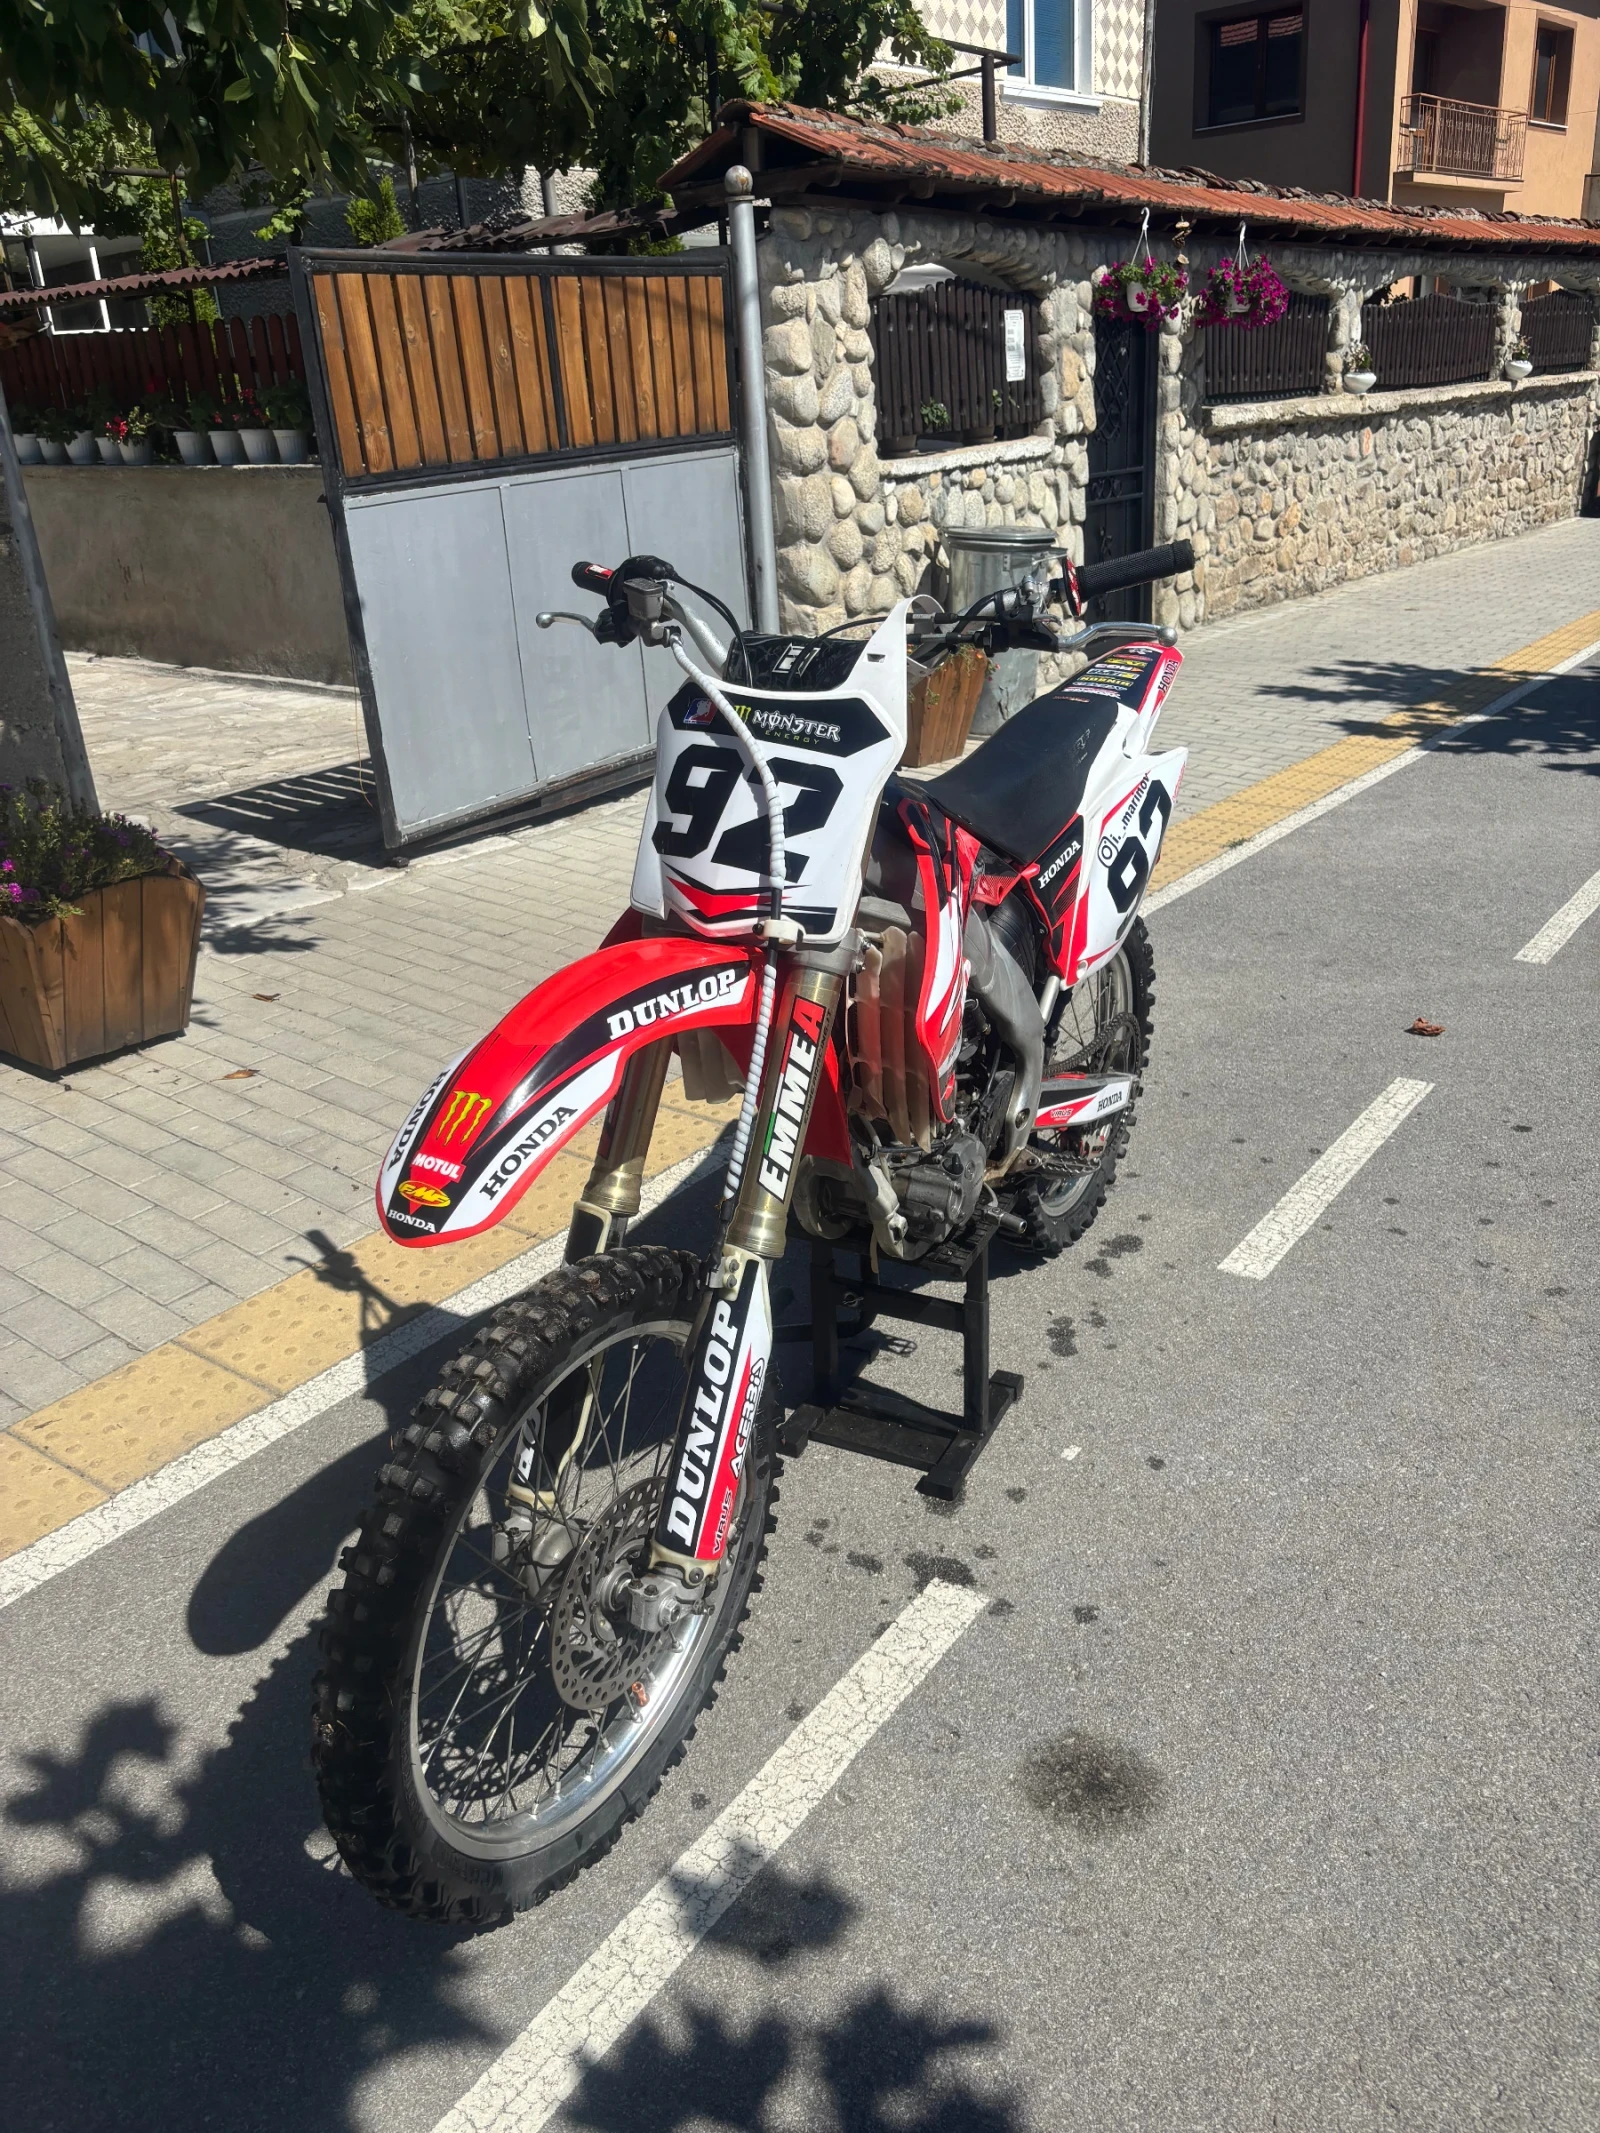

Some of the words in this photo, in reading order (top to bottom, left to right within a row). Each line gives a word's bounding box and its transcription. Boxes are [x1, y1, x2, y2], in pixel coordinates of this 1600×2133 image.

[1157, 659, 1179, 693] HONDA
[752, 709, 841, 742] MONSTER
[765, 730, 820, 745] ENERGY
[651, 744, 844, 884] 92
[1038, 840, 1082, 890] HONDA
[606, 968, 737, 1041] DUNLOP
[1050, 1108, 1074, 1118] VIRUS
[1097, 1091, 1122, 1112] HONDA
[387, 1068, 451, 1172] HONDA
[412, 1152, 461, 1179] MOTUL
[479, 1103, 578, 1200] HONDA
[399, 1183, 450, 1206] FMF
[388, 1209, 437, 1233] HONDA
[667, 1299, 739, 1547] DUNLOP
[712, 1485, 733, 1555] VIRUS
